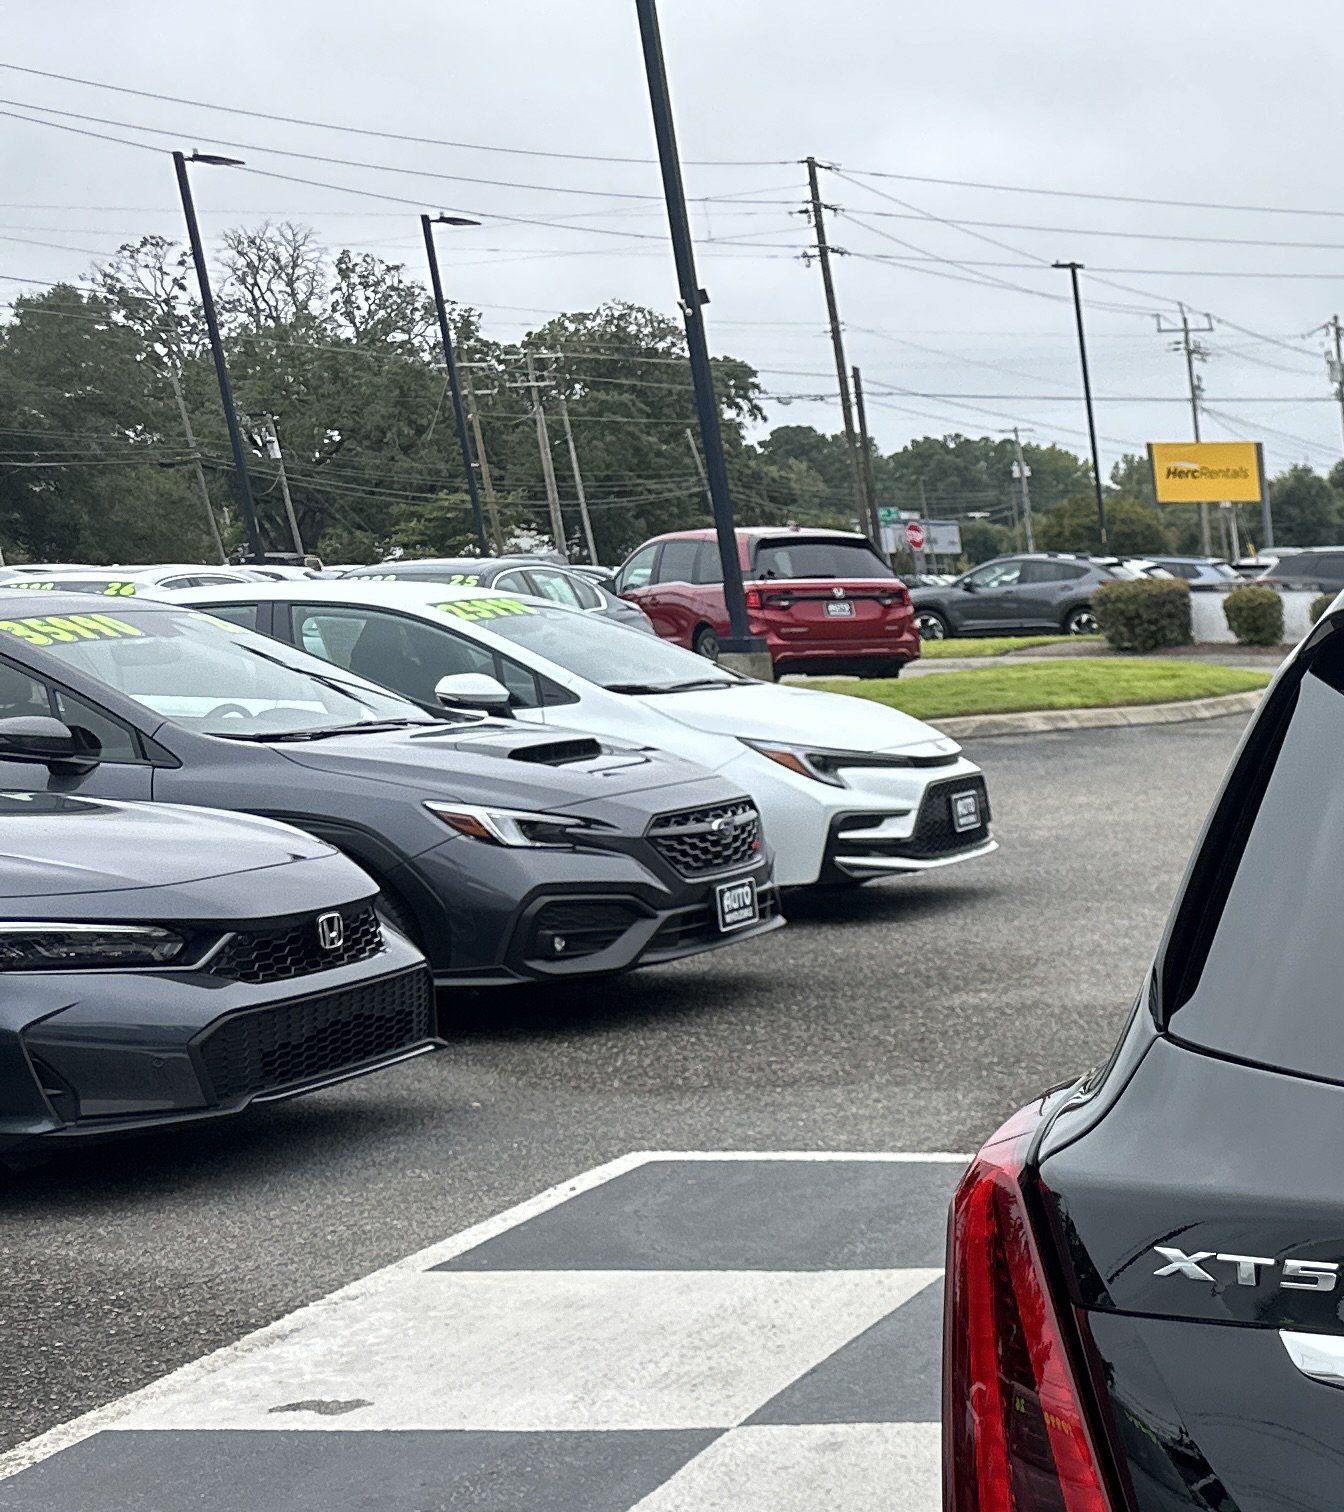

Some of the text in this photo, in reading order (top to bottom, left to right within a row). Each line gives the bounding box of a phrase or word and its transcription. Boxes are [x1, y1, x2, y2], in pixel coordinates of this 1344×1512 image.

[104, 582, 136, 596] 26
[723, 885, 752, 913] AUTO
[1153, 1246, 1341, 1292] XT5
